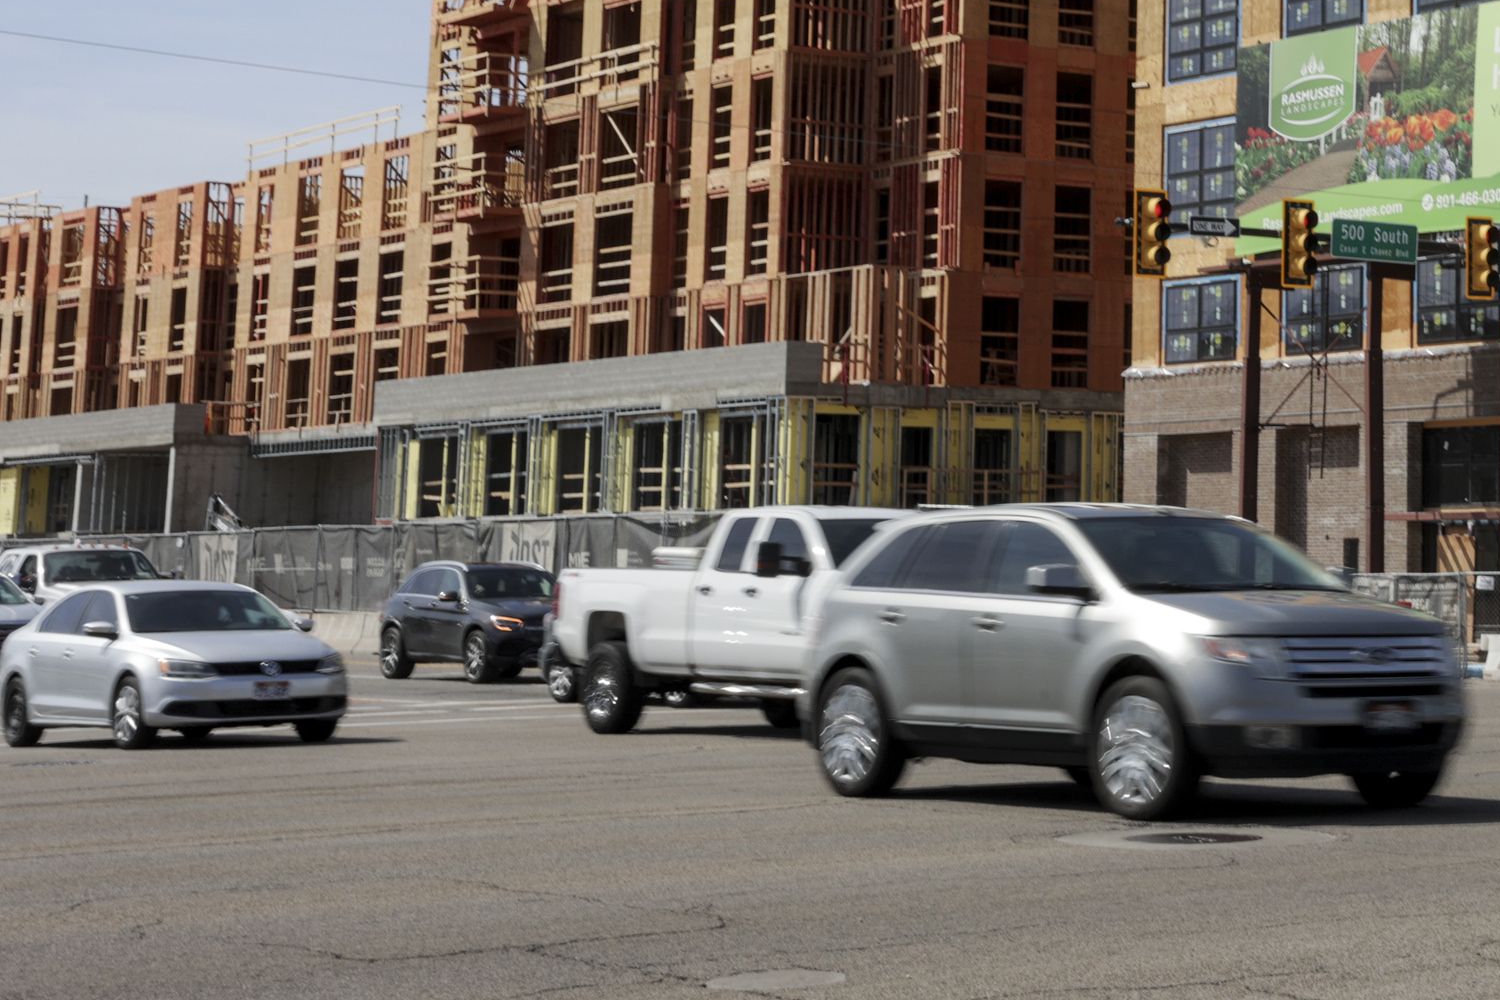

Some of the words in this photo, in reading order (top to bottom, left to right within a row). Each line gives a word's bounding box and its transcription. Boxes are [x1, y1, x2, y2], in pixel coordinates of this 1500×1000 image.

[1281, 83, 1344, 106] RASMUSSEN
[1280, 97, 1345, 117] LANDSCAPES
[1263, 202, 1403, 229] RasLandscapes.com
[1341, 223, 1366, 242] 500
[1374, 226, 1410, 246] South
